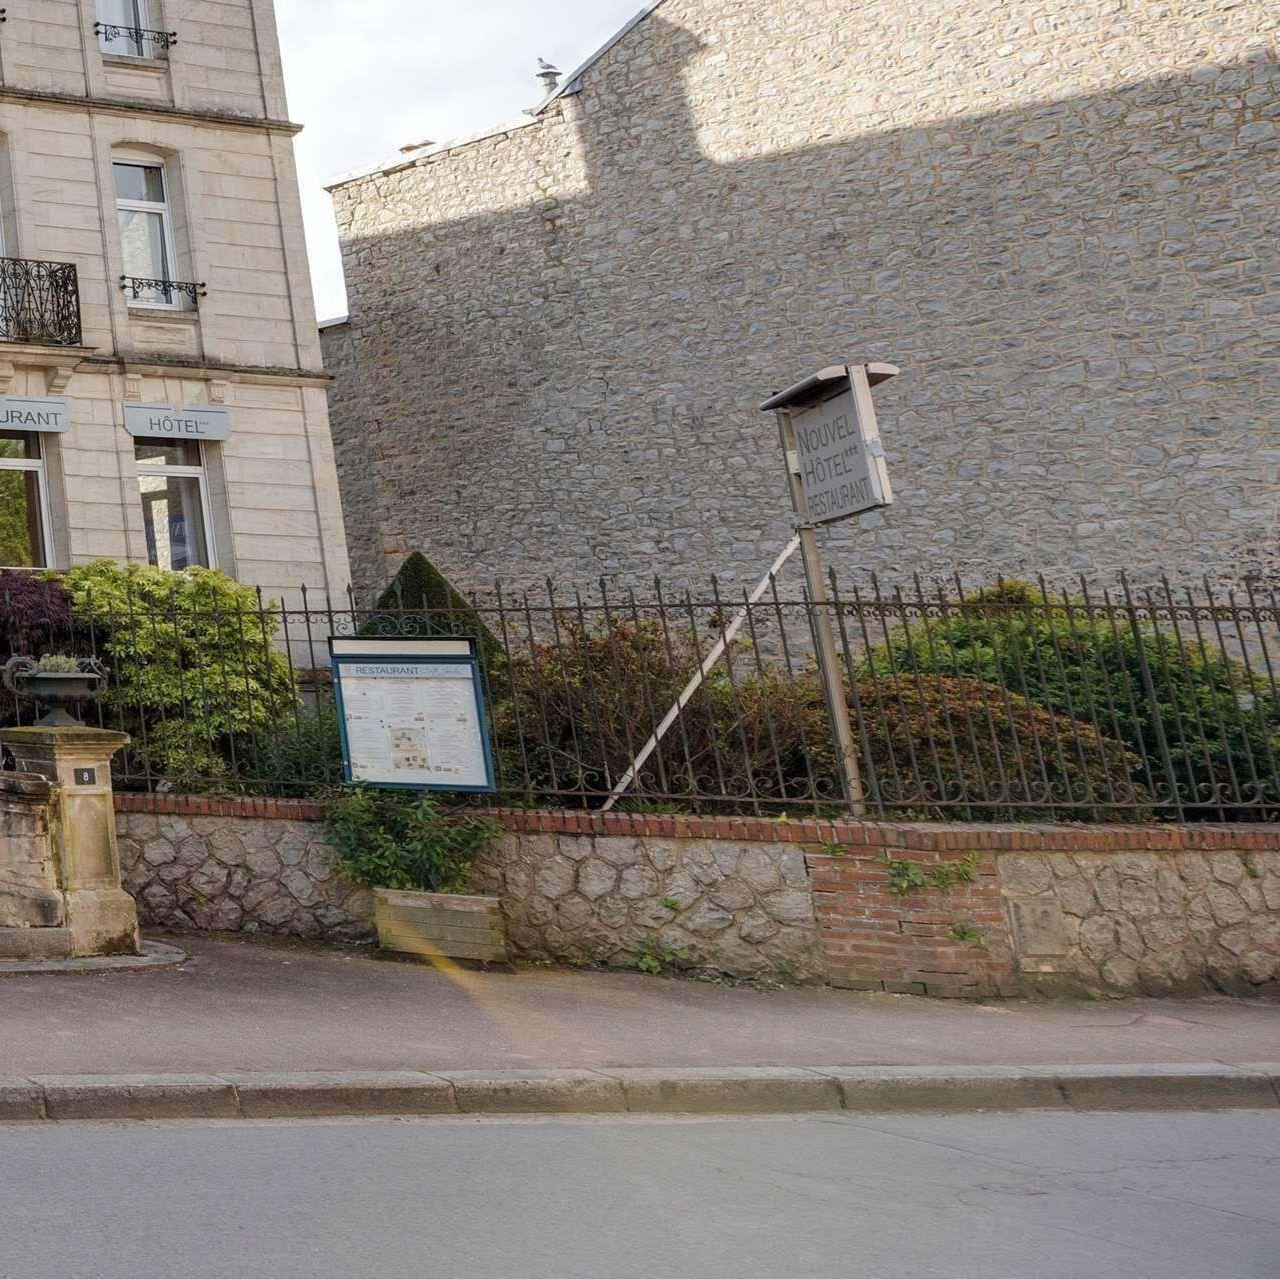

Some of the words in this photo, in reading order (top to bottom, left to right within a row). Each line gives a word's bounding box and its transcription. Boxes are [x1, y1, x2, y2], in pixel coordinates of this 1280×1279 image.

[149, 415, 205, 434] HÔTEL
[797, 414, 855, 456] NOUVEL
[807, 476, 870, 518] RESTAURANT
[355, 666, 420, 675] RESTAURANT
[82, 771, 89, 781] 8
